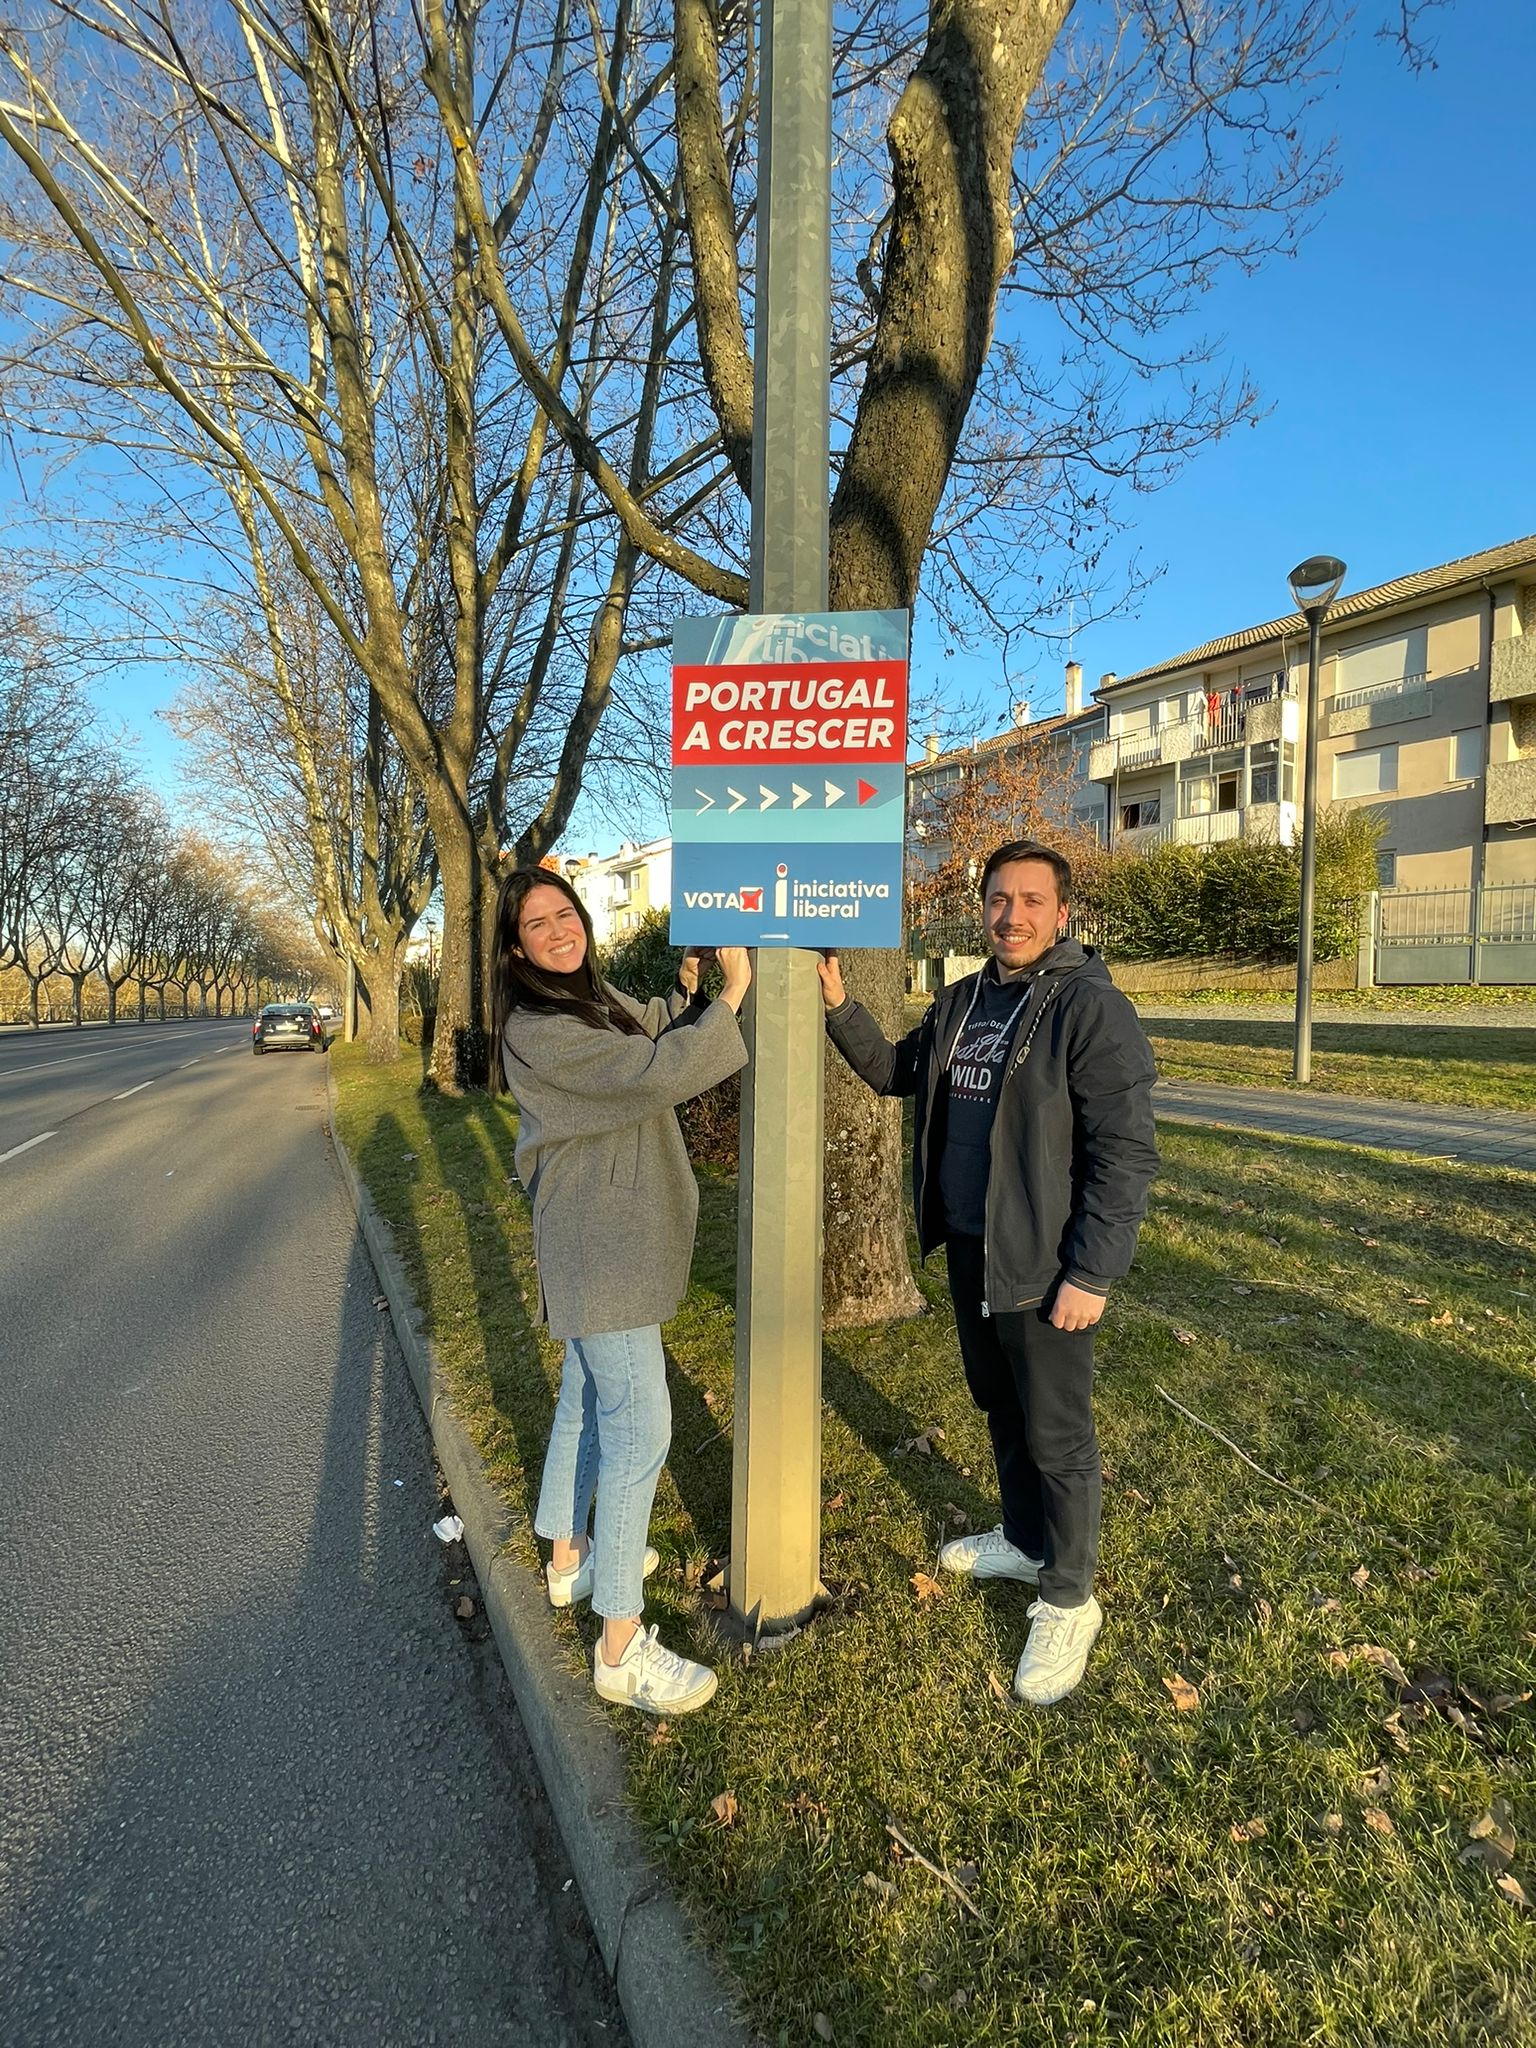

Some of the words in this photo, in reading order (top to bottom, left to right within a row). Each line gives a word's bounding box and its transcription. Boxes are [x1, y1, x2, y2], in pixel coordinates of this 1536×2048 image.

[685, 679, 894, 711] PORTUGAL
[681, 722, 710, 751] A
[719, 718, 894, 750] CRESCER
[793, 880, 889, 898] iniciativa
[684, 892, 739, 909] VOTA
[793, 899, 859, 918] liberal
[951, 1064, 992, 1090] WILD
